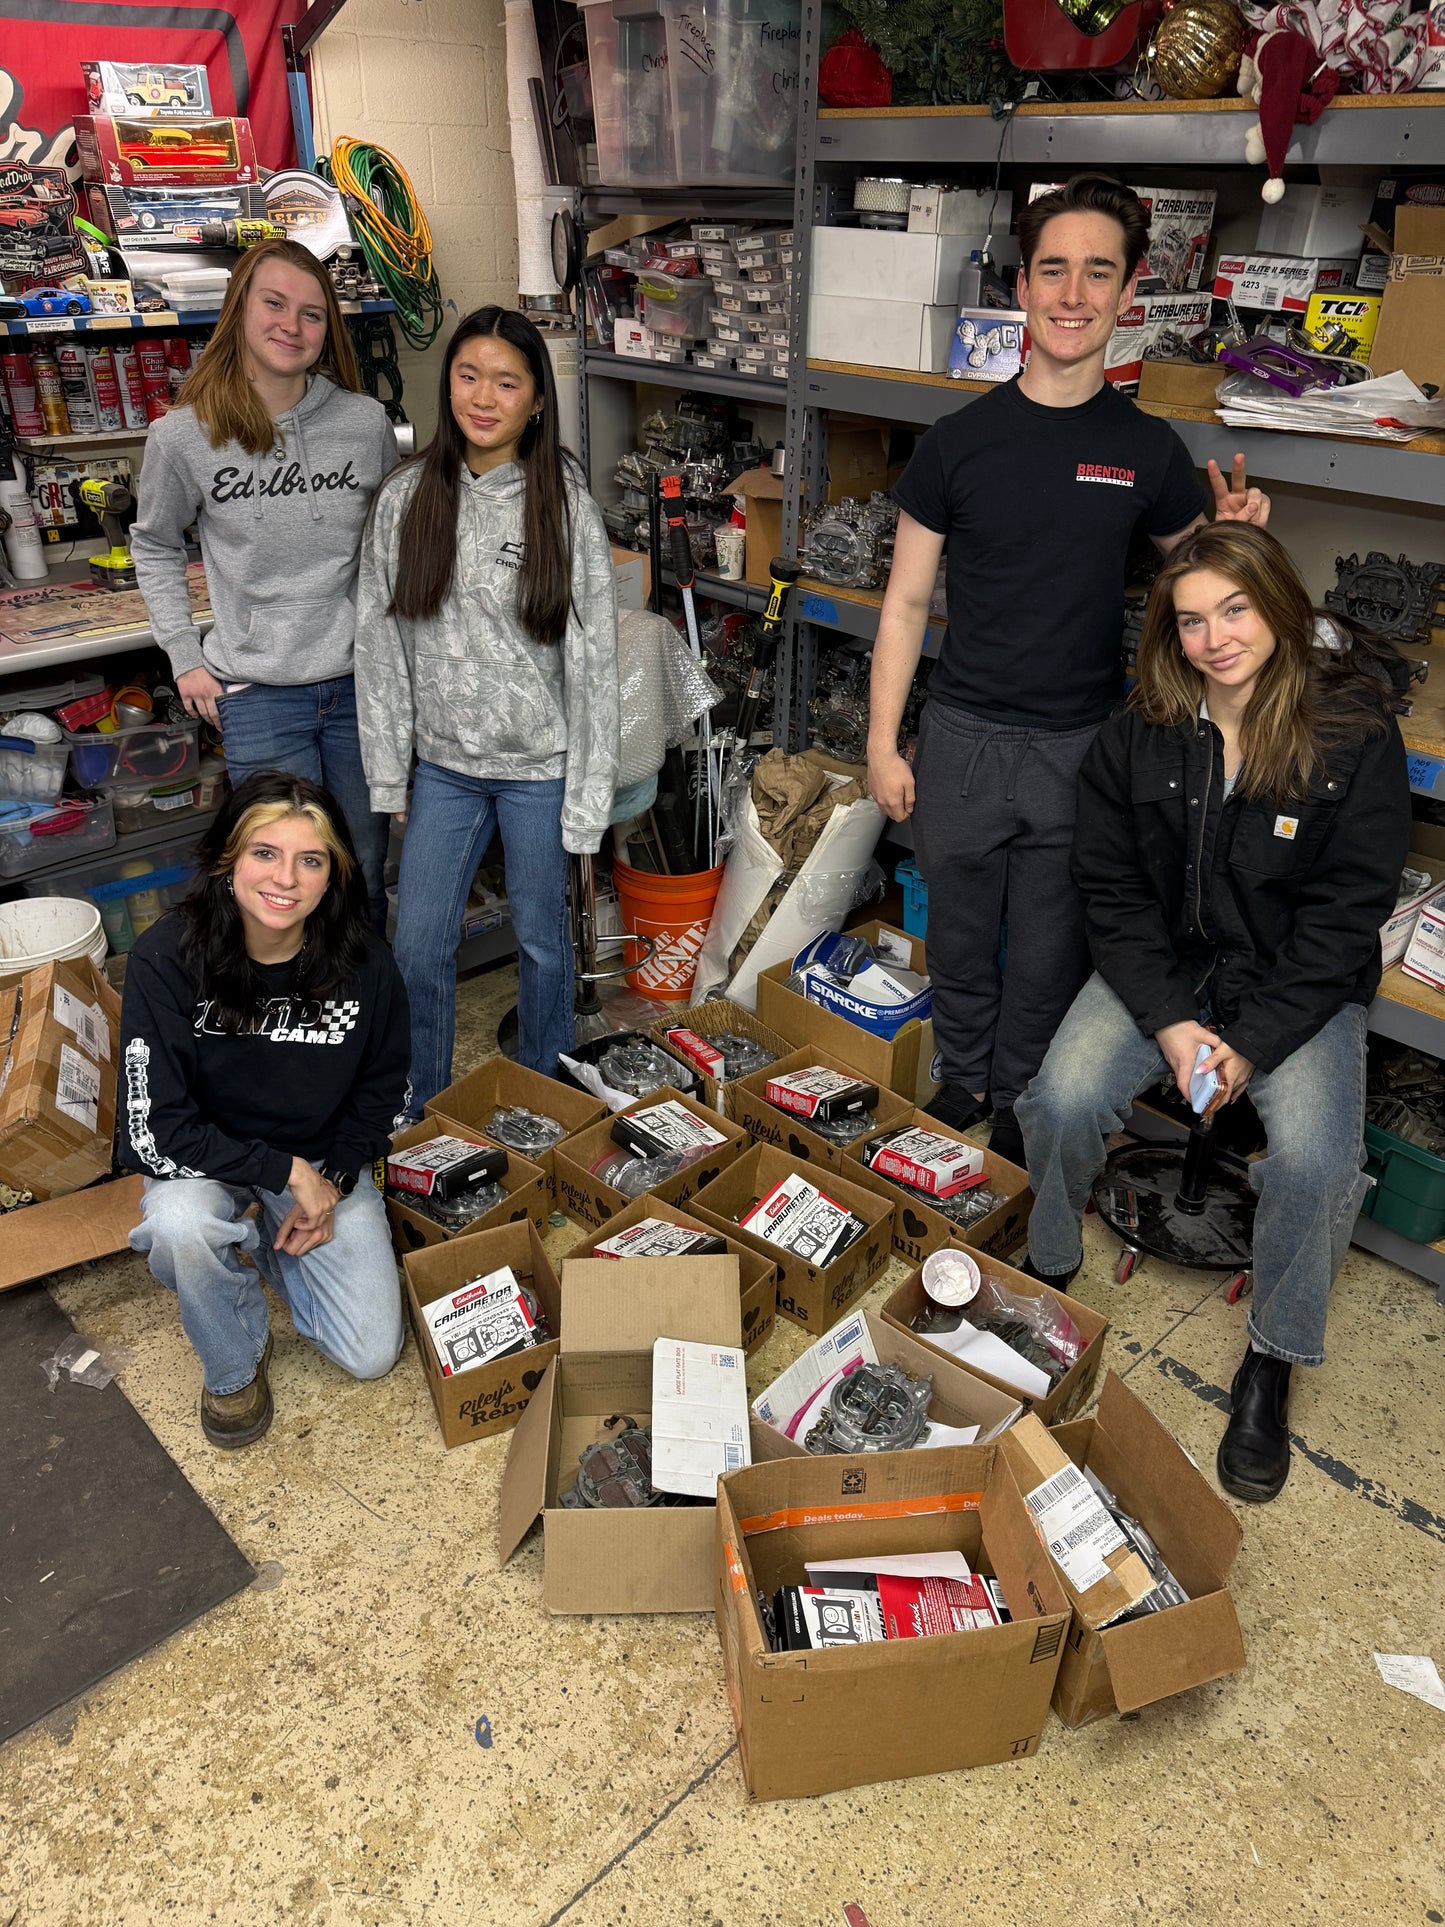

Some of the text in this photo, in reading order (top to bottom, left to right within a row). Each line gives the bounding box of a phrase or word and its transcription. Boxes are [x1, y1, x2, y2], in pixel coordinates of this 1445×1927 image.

[761, 21, 801, 48] Fireplac
[1154, 199, 1213, 214] CARBURETOR
[43, 258, 83, 276] FAIRGROUNDS
[1247, 264, 1270, 273] ELITE
[1278, 267, 1309, 276] SERIES
[1240, 280, 1260, 289] 4273
[1120, 303, 1209, 321] Edelbrock CARBURETOR
[1179, 313, 1200, 322] AVS
[211, 460, 359, 503] Edelbrock
[1077, 463, 1135, 481] BRENTON
[664, 957, 699, 991] DEP
[1410, 957, 1430, 971] TRACKED
[810, 979, 878, 1020] STARCKE
[881, 979, 908, 1000] STARCKE
[270, 1028, 345, 1045] CAMS
[743, 1113, 784, 1143] Riley's
[560, 1180, 592, 1205] Riley's
[568, 1196, 605, 1228] Rebu
[763, 1186, 810, 1239] CARBURETOR
[614, 1222, 667, 1252] CARBURETOR
[433, 1285, 512, 1329] CARBURETOR
[459, 1379, 515, 1419] Riley's
[470, 1398, 529, 1428] Rebu
[804, 1512, 865, 1523] Deals today.
[908, 1602, 924, 1637] lbrock
